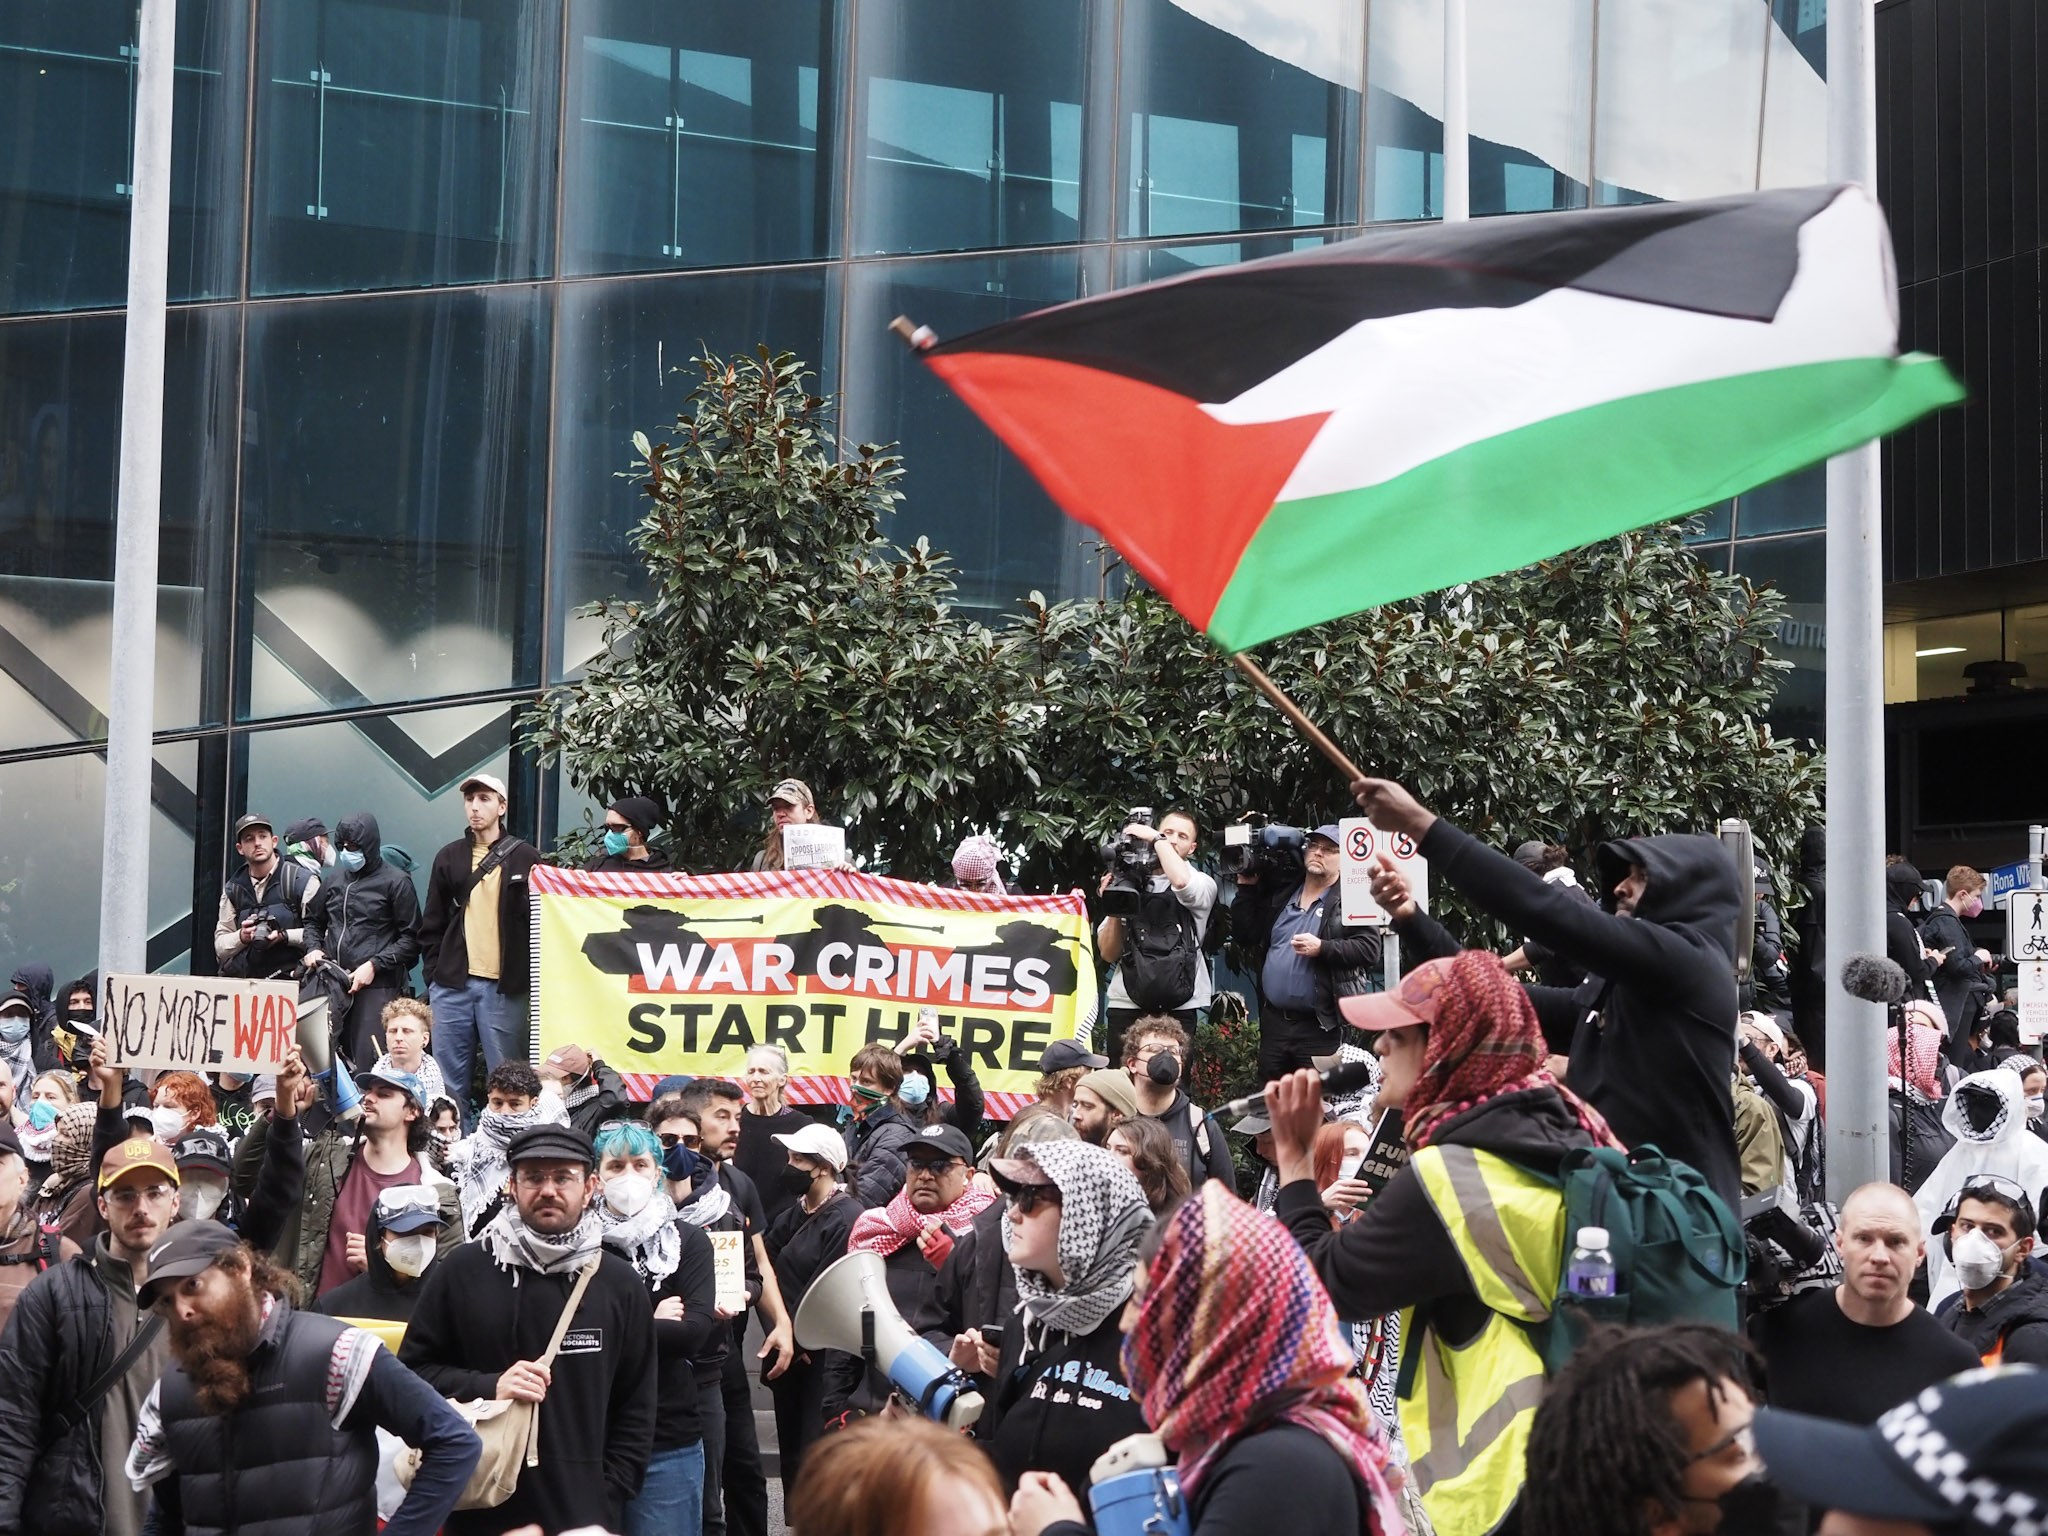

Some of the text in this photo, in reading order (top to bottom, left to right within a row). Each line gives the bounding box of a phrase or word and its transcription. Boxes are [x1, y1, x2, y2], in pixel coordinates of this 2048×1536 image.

[791, 843, 813, 856] OPPOSE
[1351, 867, 1370, 876] BUSE
[1347, 876, 1373, 885] EXCEPTE
[1993, 872, 2014, 892] Rona
[635, 941, 1051, 1008] WAR CRIMES
[102, 976, 297, 1064] NO MORE WAR
[626, 1002, 847, 1054] START
[127, 1144, 150, 1156] ups
